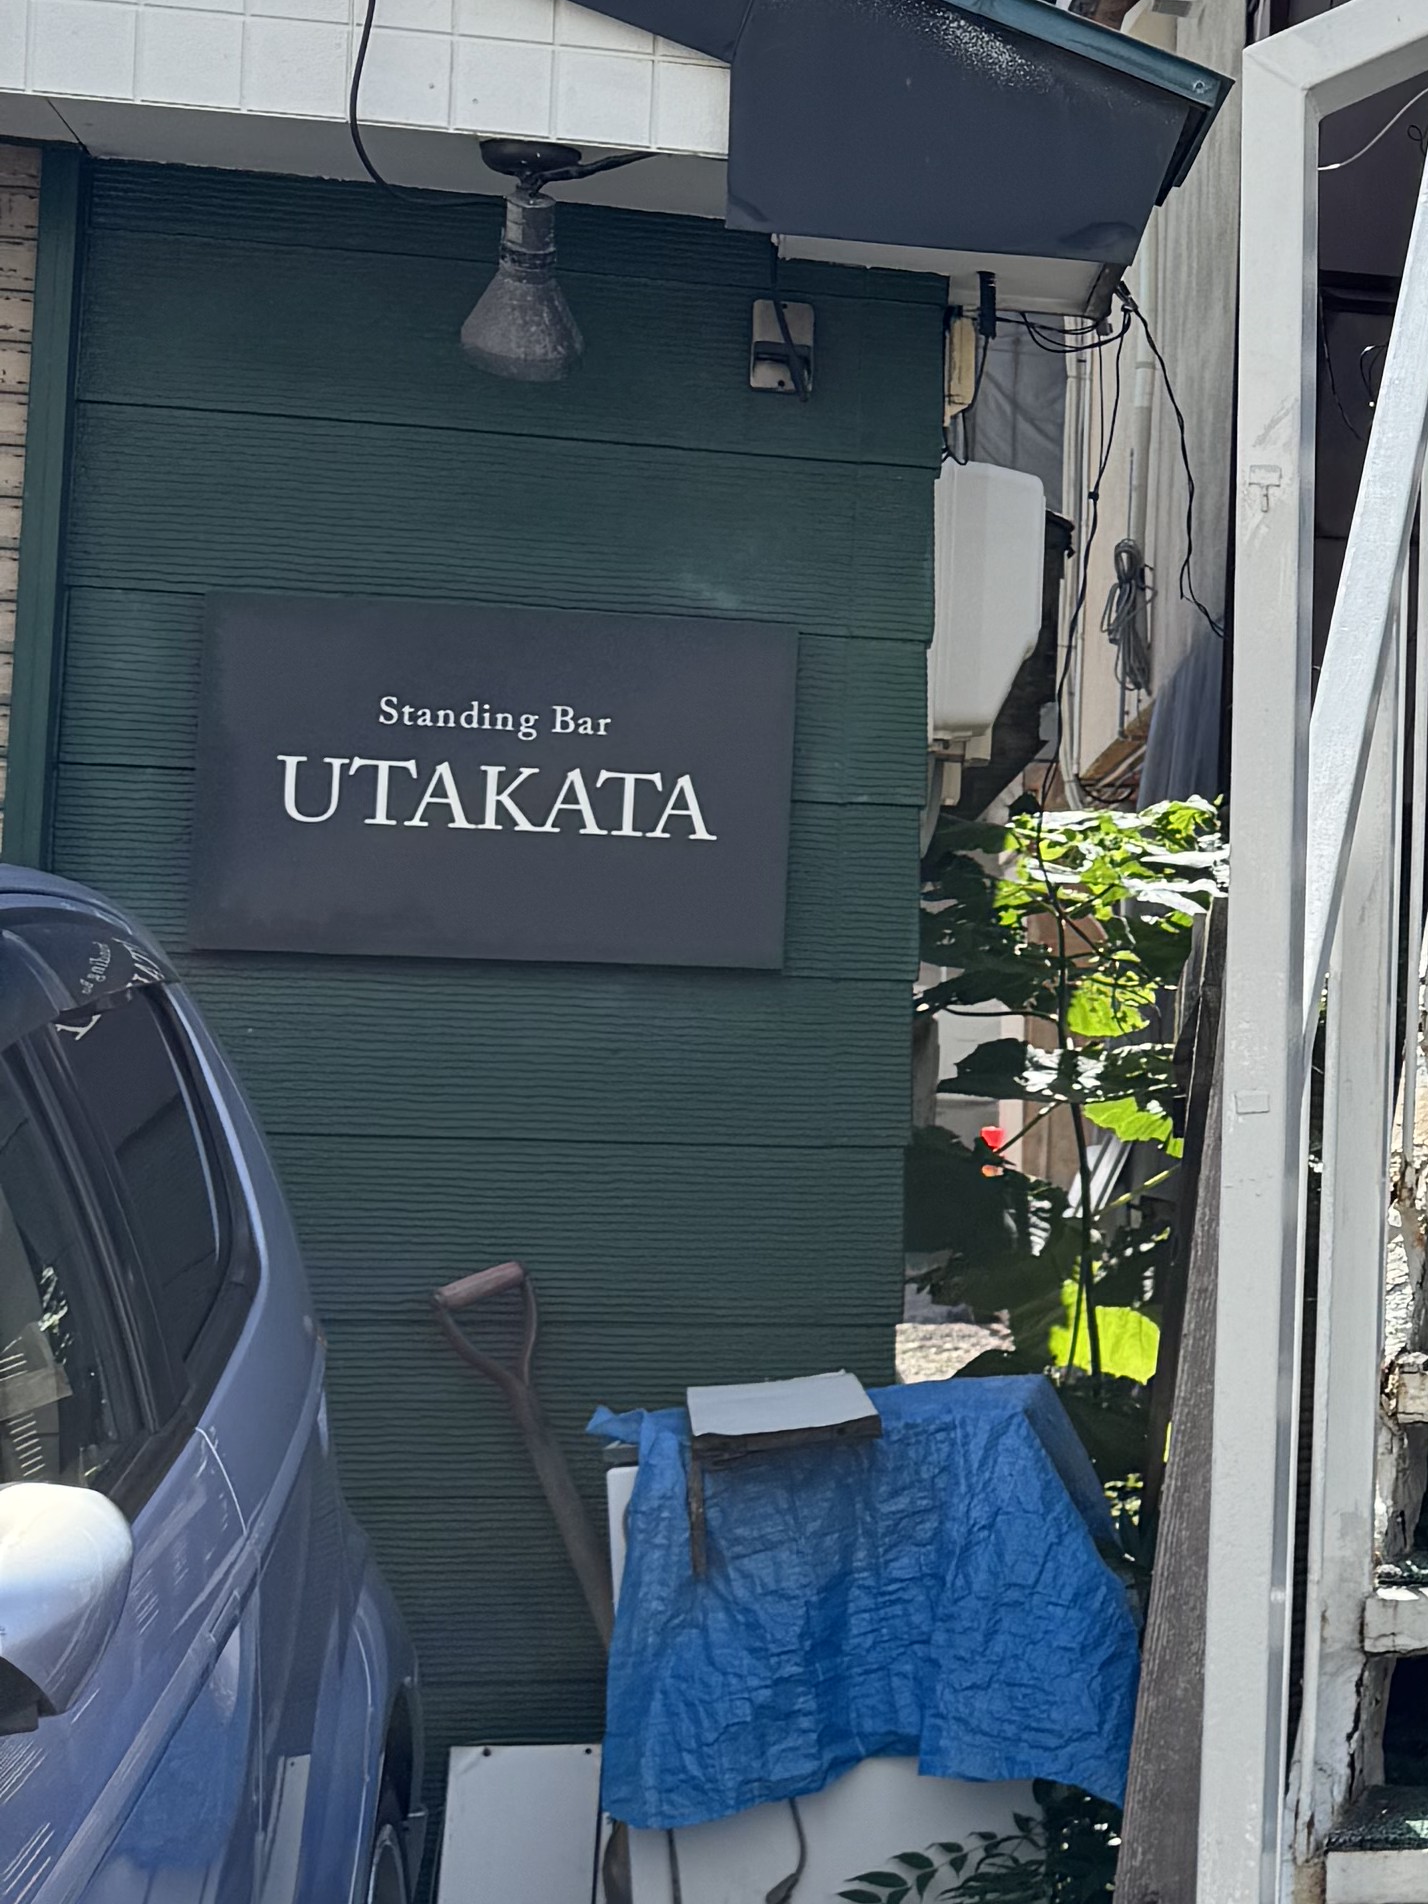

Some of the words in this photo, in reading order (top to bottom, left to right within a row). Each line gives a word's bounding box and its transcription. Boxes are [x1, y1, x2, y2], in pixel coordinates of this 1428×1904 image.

[378, 696, 539, 741] Standing
[551, 705, 612, 736] Bar
[276, 753, 718, 842] UTAKATA
